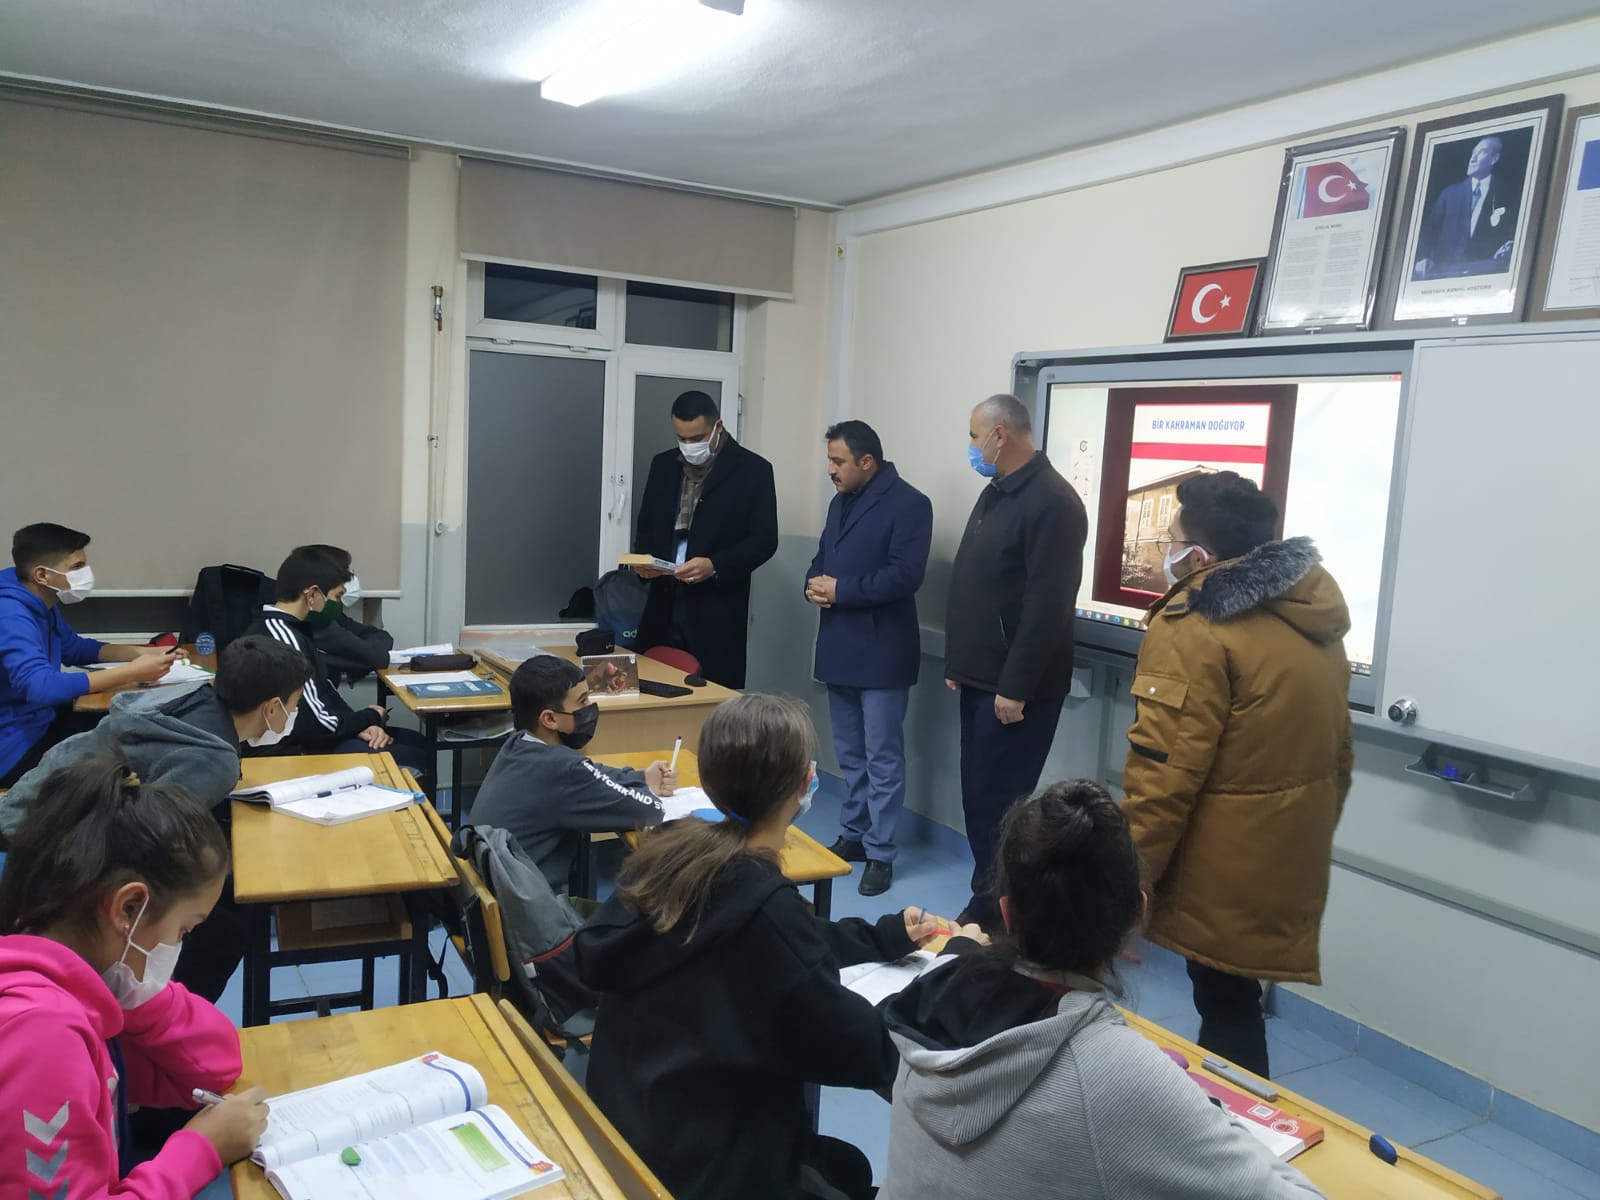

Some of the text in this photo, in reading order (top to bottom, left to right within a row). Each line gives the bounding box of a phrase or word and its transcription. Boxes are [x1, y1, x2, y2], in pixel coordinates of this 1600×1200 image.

[1152, 418, 1245, 431] BİR KAHRAMAN DOĞUYOR
